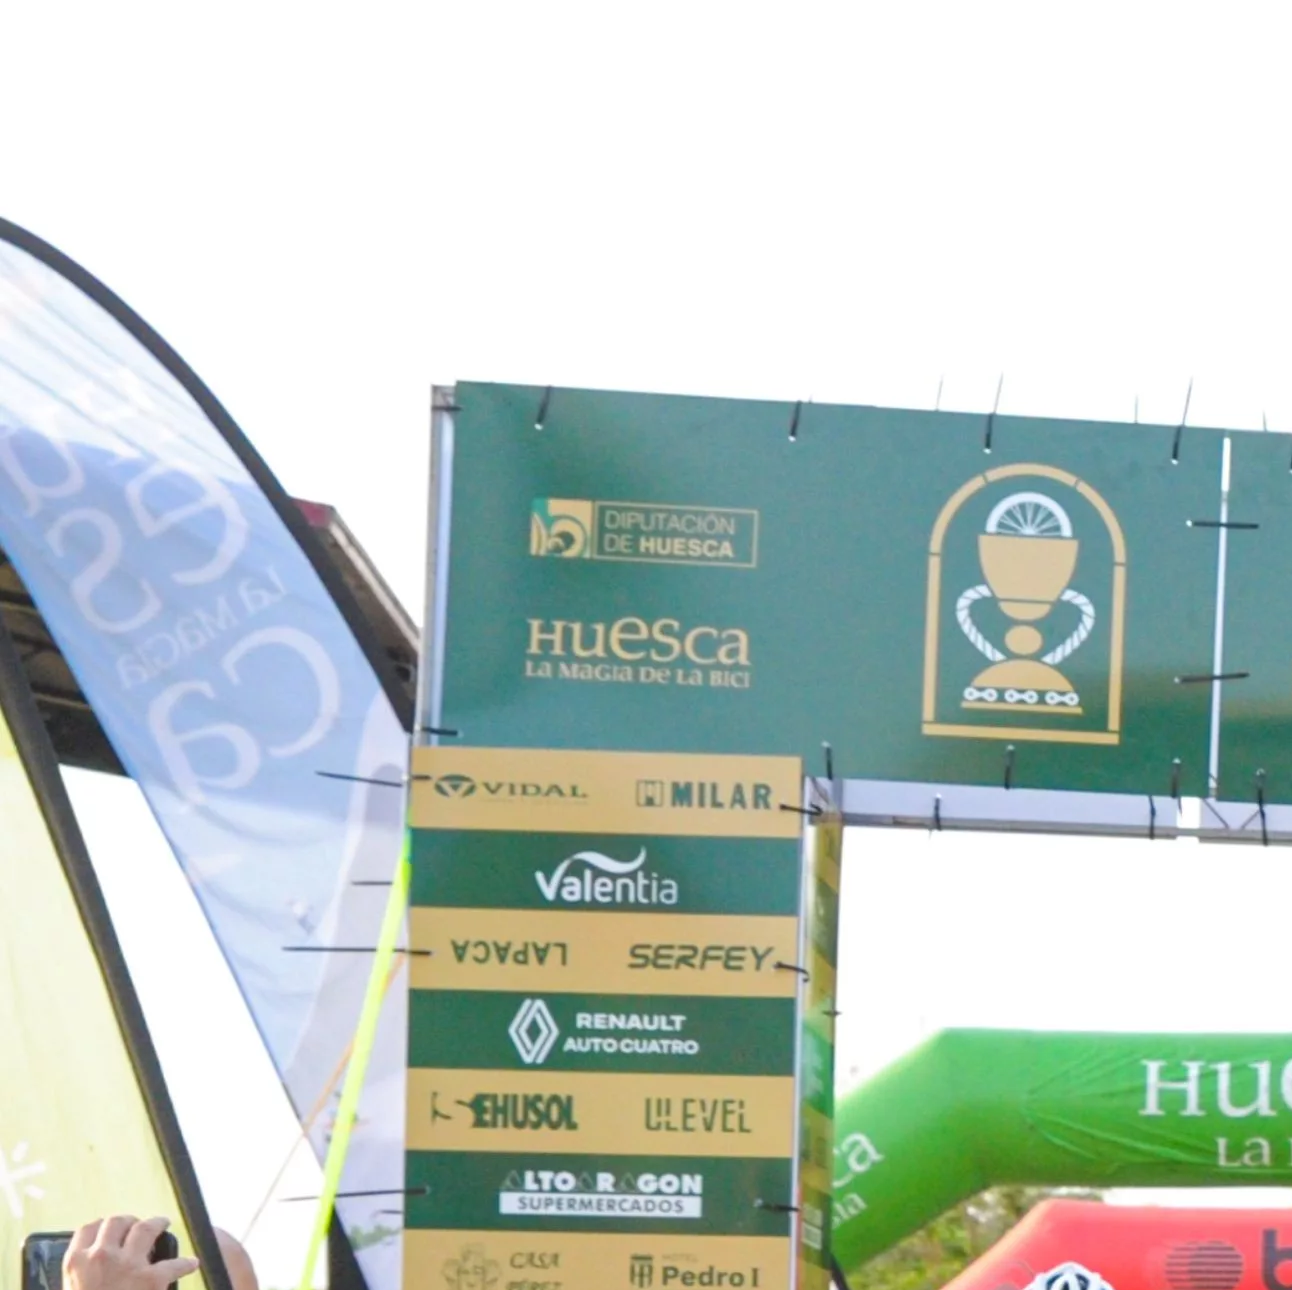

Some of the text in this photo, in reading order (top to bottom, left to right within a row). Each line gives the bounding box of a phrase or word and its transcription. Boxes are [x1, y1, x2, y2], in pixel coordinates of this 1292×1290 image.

[604, 509, 736, 535] DIPUTACIÓN
[603, 533, 736, 559] DE HUESCA
[525, 615, 752, 665] Huesca
[709, 670, 751, 688] BICI
[482, 780, 590, 800] VIDAL
[671, 781, 773, 810] MILAR
[535, 847, 679, 905] Valentia
[450, 939, 569, 967] LAPACA
[628, 943, 777, 971] SERFEY
[576, 1012, 686, 1033] RENAULT
[517, 1196, 685, 1214] SUPERMERCADOS
[662, 1265, 760, 1288] Pedro I
